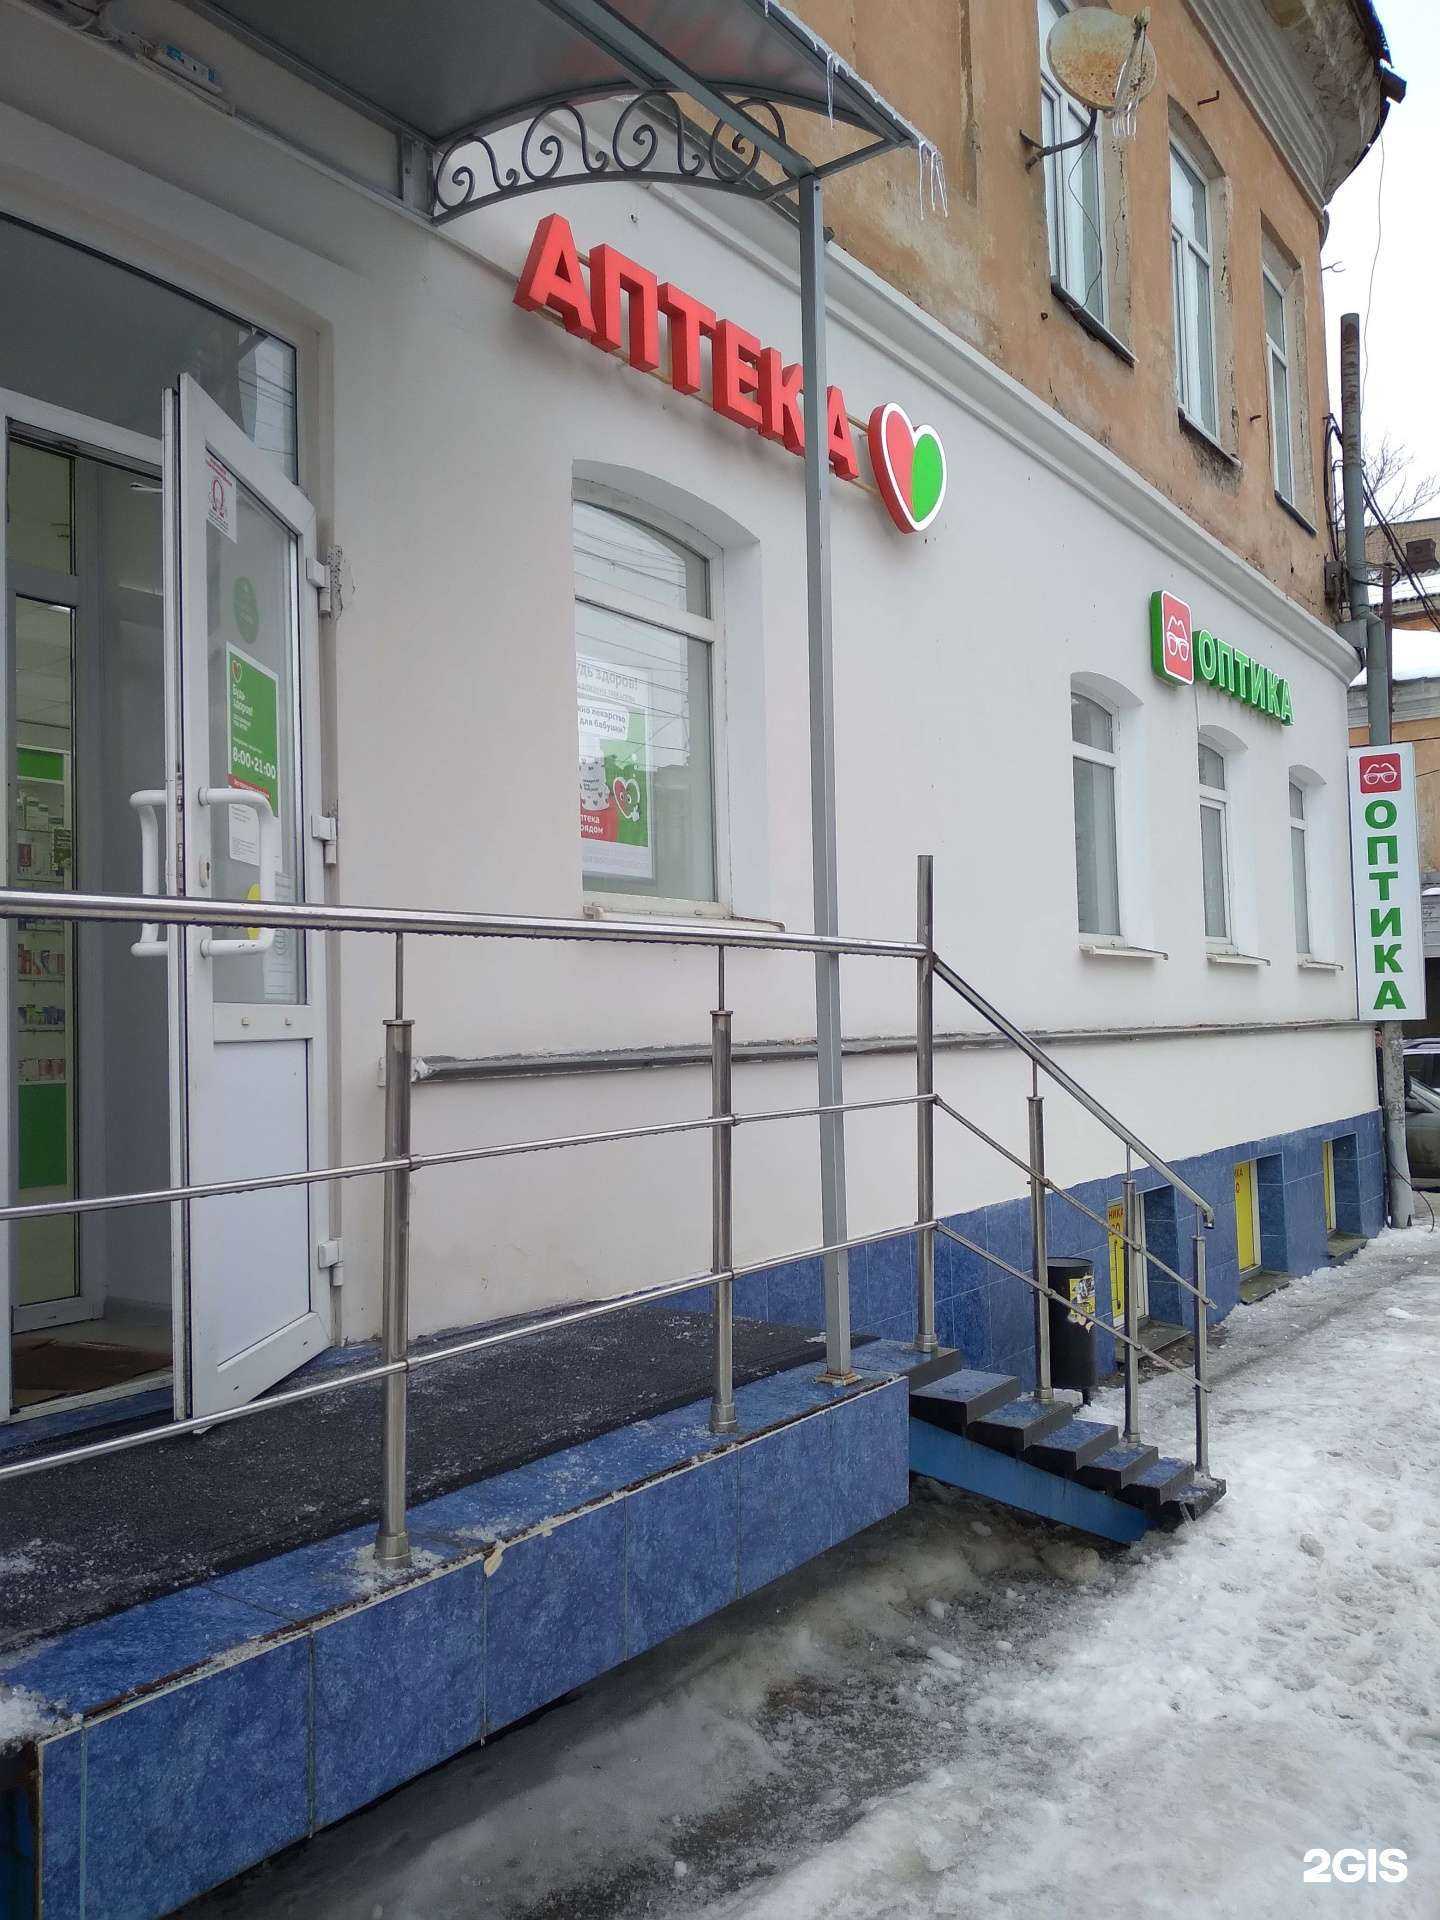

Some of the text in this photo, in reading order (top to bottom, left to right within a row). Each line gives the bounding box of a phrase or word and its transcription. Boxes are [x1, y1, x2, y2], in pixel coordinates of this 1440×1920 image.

[513, 213, 858, 481] АПТЕКА
[1193, 629, 1294, 726] ОПТИКА
[1364, 799, 1406, 1010] ОПТИКА
